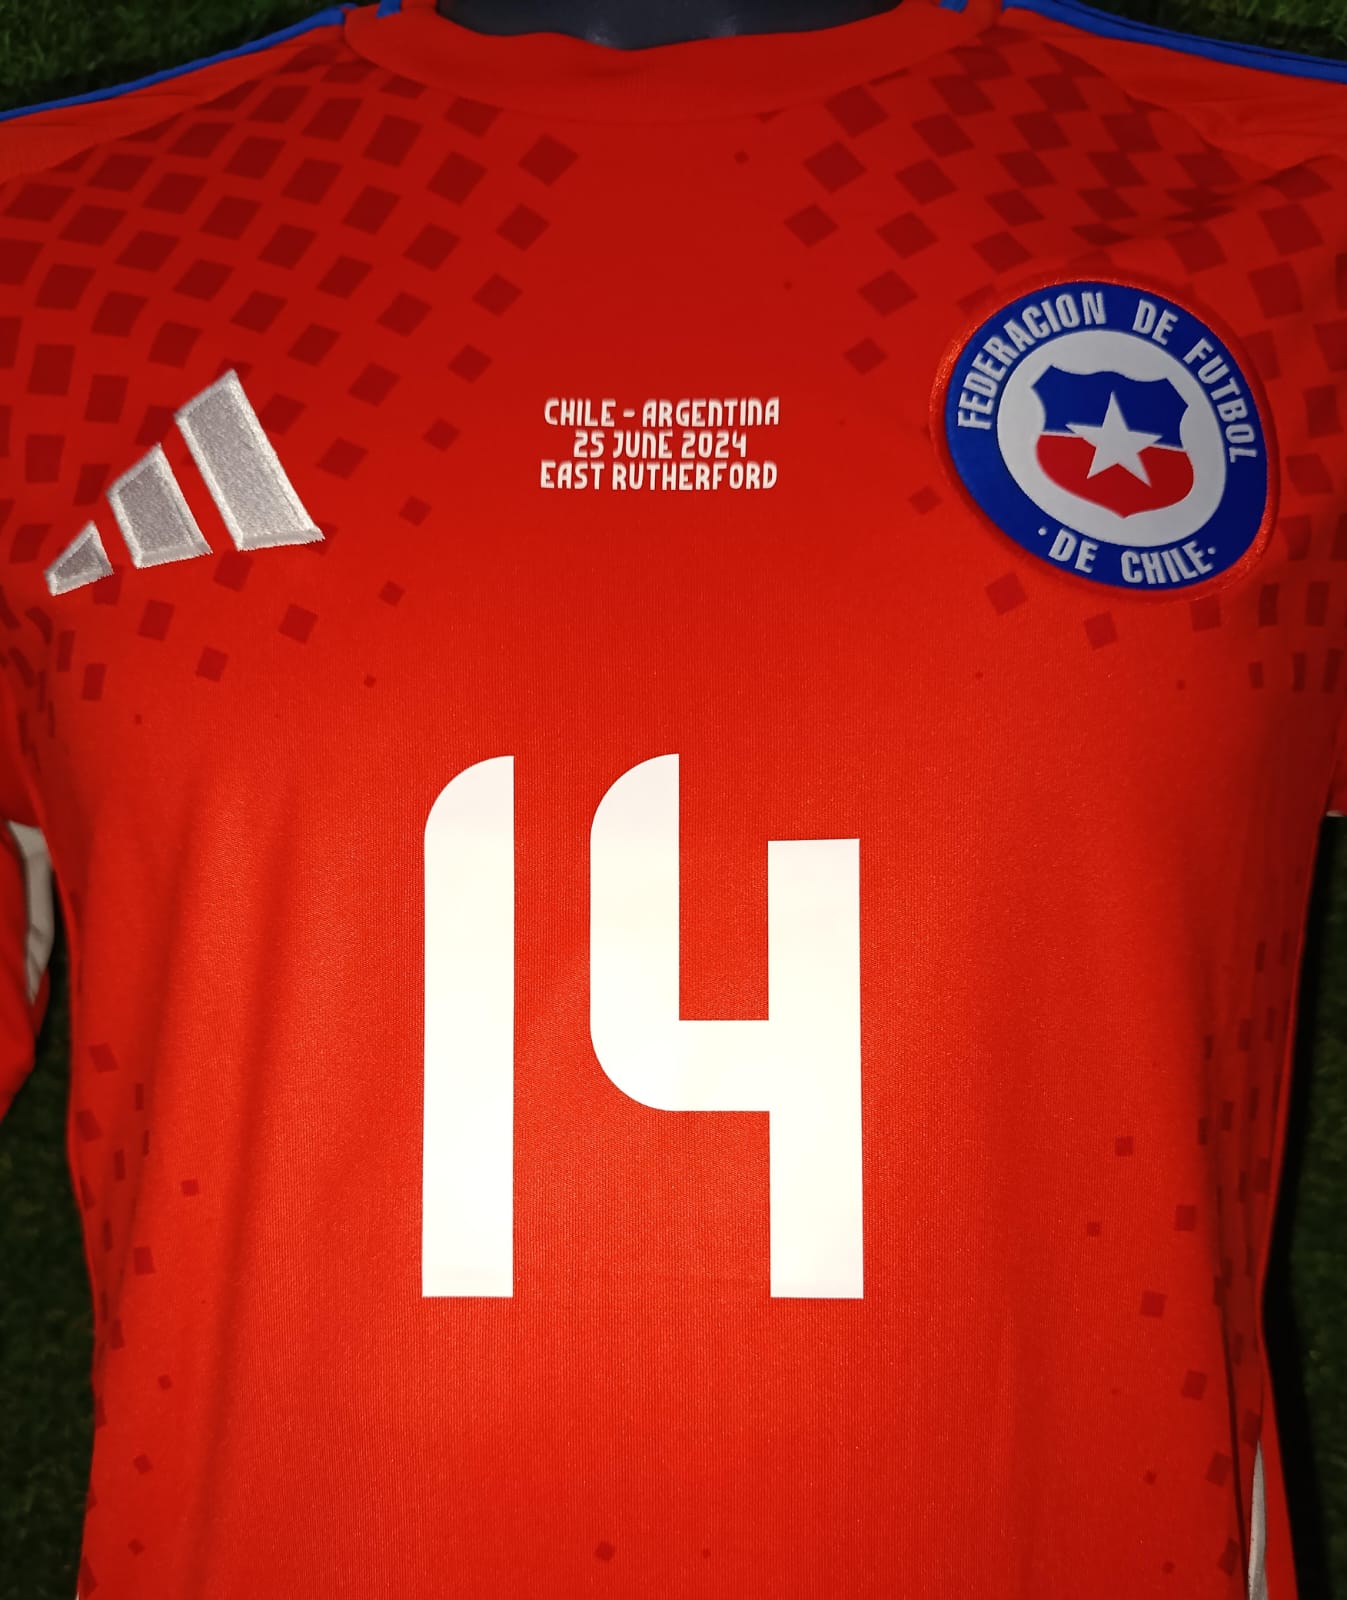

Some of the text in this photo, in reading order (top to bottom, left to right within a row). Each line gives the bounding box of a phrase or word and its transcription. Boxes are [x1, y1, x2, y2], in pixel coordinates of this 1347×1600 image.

[957, 291, 1258, 464] FEDERACION DE FUTBOL
[544, 397, 617, 427] CHILE
[642, 396, 780, 427] ARGENTINA
[573, 430, 747, 459] 25 JUNE 2024
[540, 459, 778, 491] EAST RUTHERFORD
[1048, 528, 1213, 585] DE CHILE
[422, 753, 864, 1299] 14
